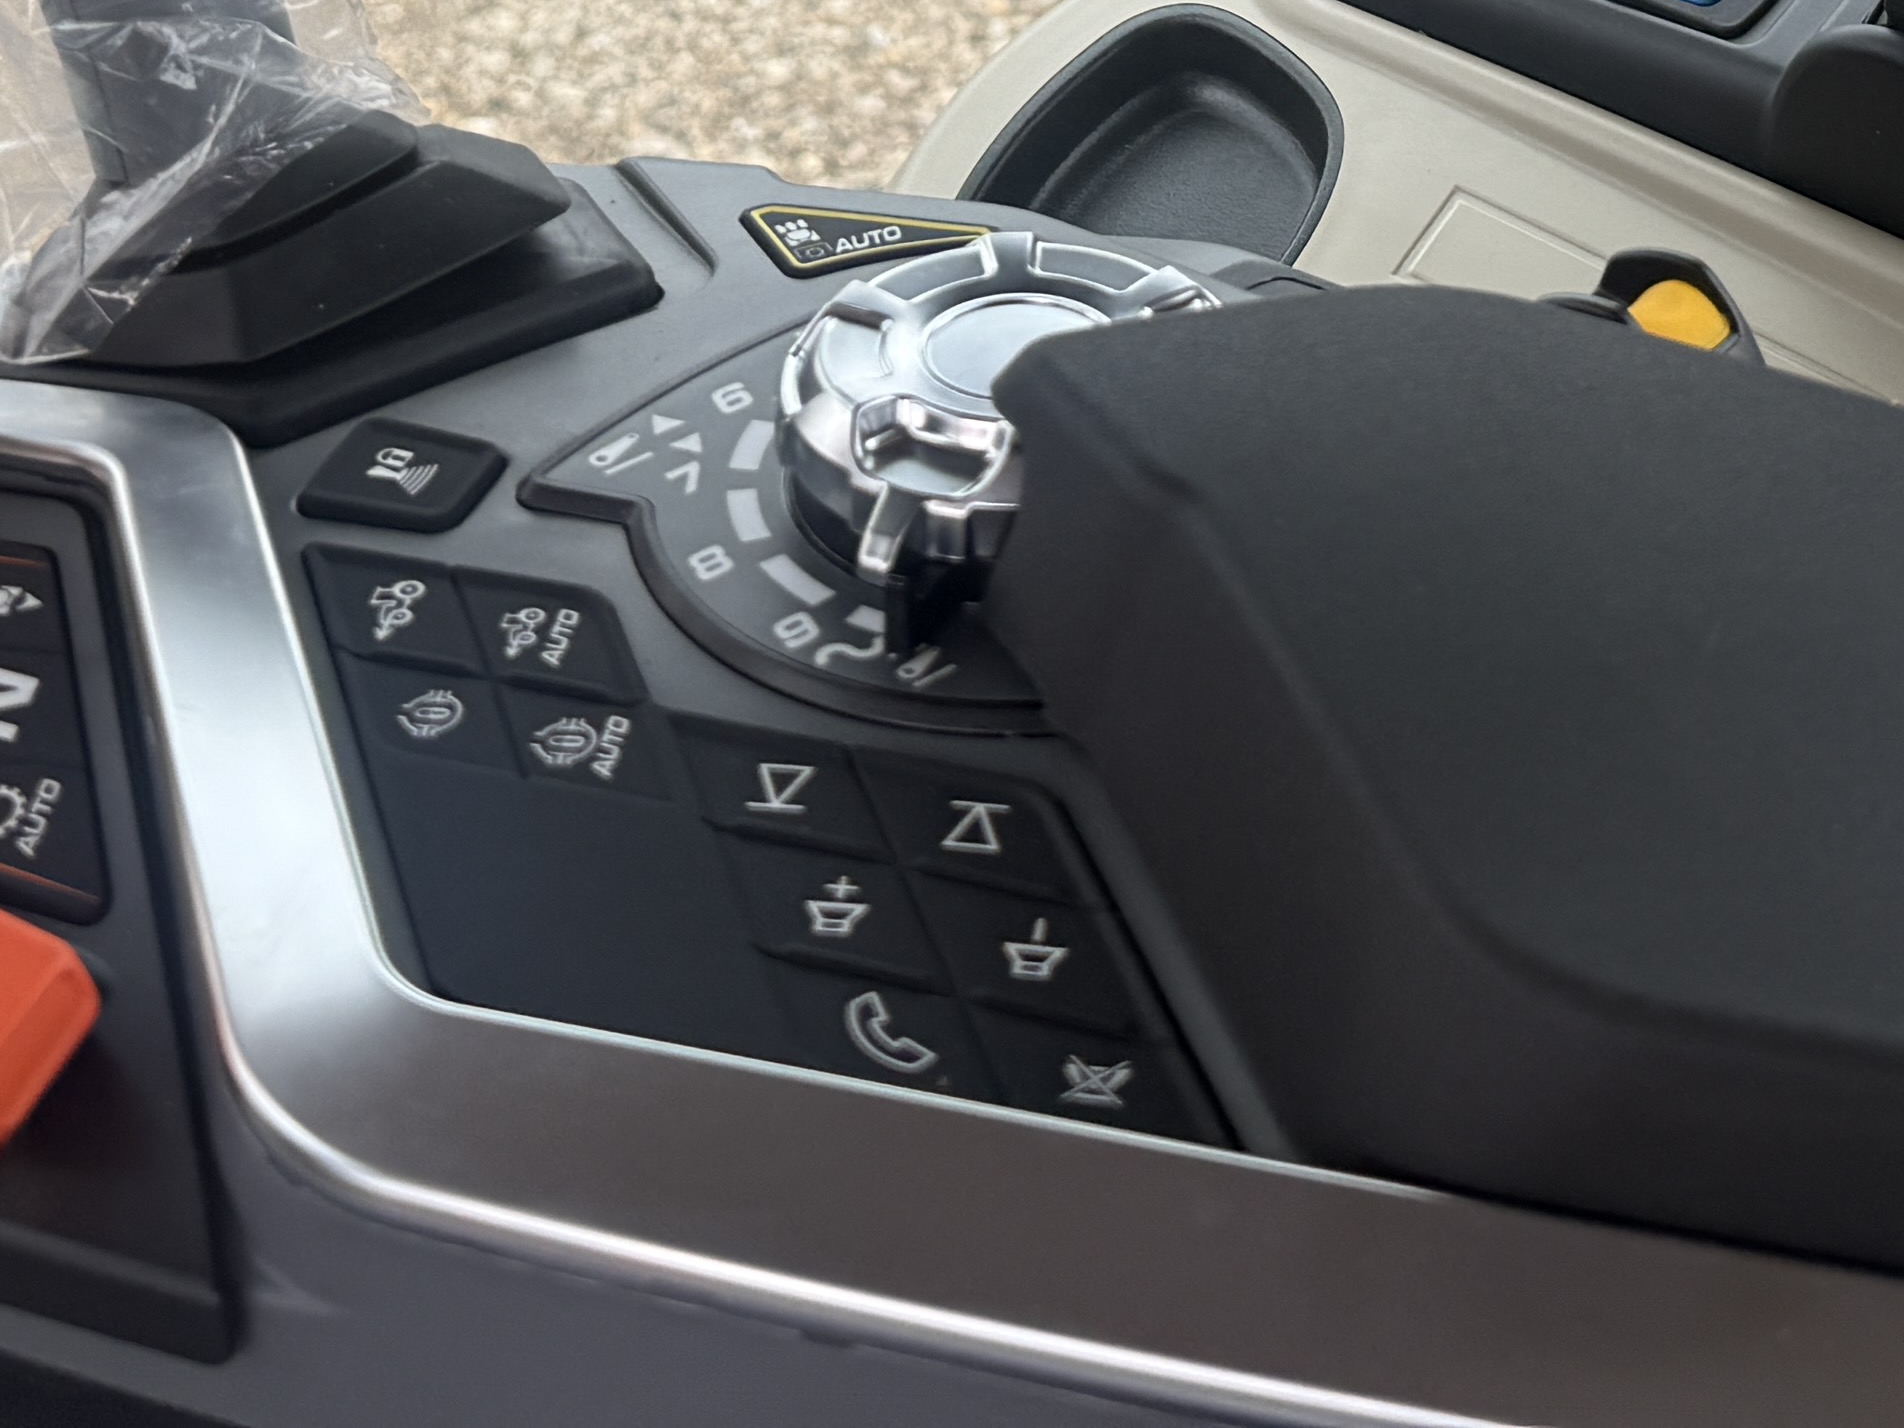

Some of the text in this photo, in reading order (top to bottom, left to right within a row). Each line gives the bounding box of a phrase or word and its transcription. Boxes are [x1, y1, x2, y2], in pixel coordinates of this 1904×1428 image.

[835, 225, 902, 254] AUTO
[711, 382, 754, 414] 6
[687, 544, 734, 580] 8
[539, 608, 581, 667] AUTO
[772, 611, 820, 647] 9
[590, 714, 631, 780] AUTO
[15, 777, 62, 858] AUTO
